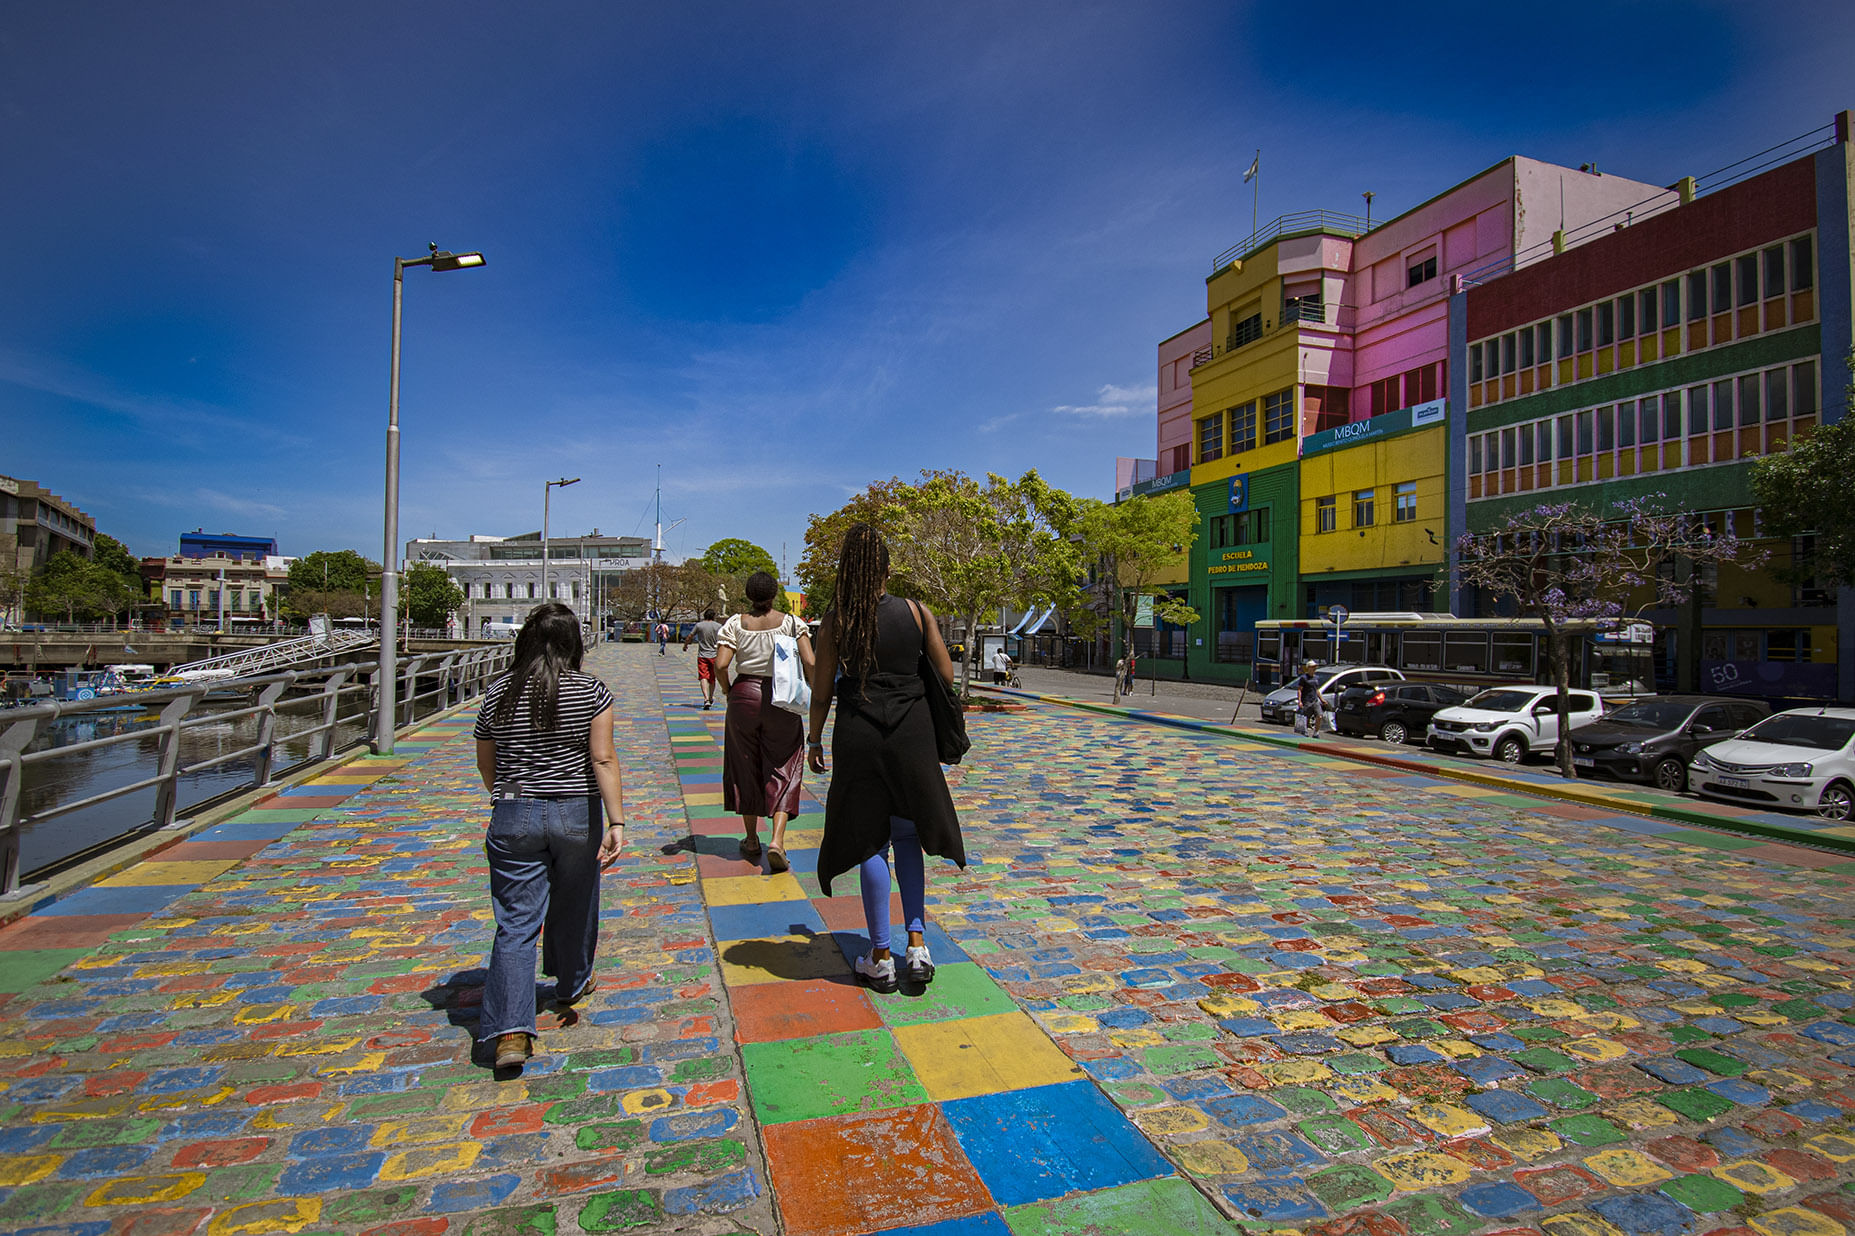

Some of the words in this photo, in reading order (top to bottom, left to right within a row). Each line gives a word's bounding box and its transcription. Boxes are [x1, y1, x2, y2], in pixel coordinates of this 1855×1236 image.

[1334, 420, 1370, 440] MBQM
[1152, 475, 1172, 488] MBQM
[1222, 550, 1252, 561] ESCUELA
[610, 558, 630, 566] PROA
[1208, 565, 1227, 574] PEDRO
[1228, 564, 1236, 572] DE
[1237, 562, 1268, 572] MENDOZA
[1711, 663, 1738, 684] 50
